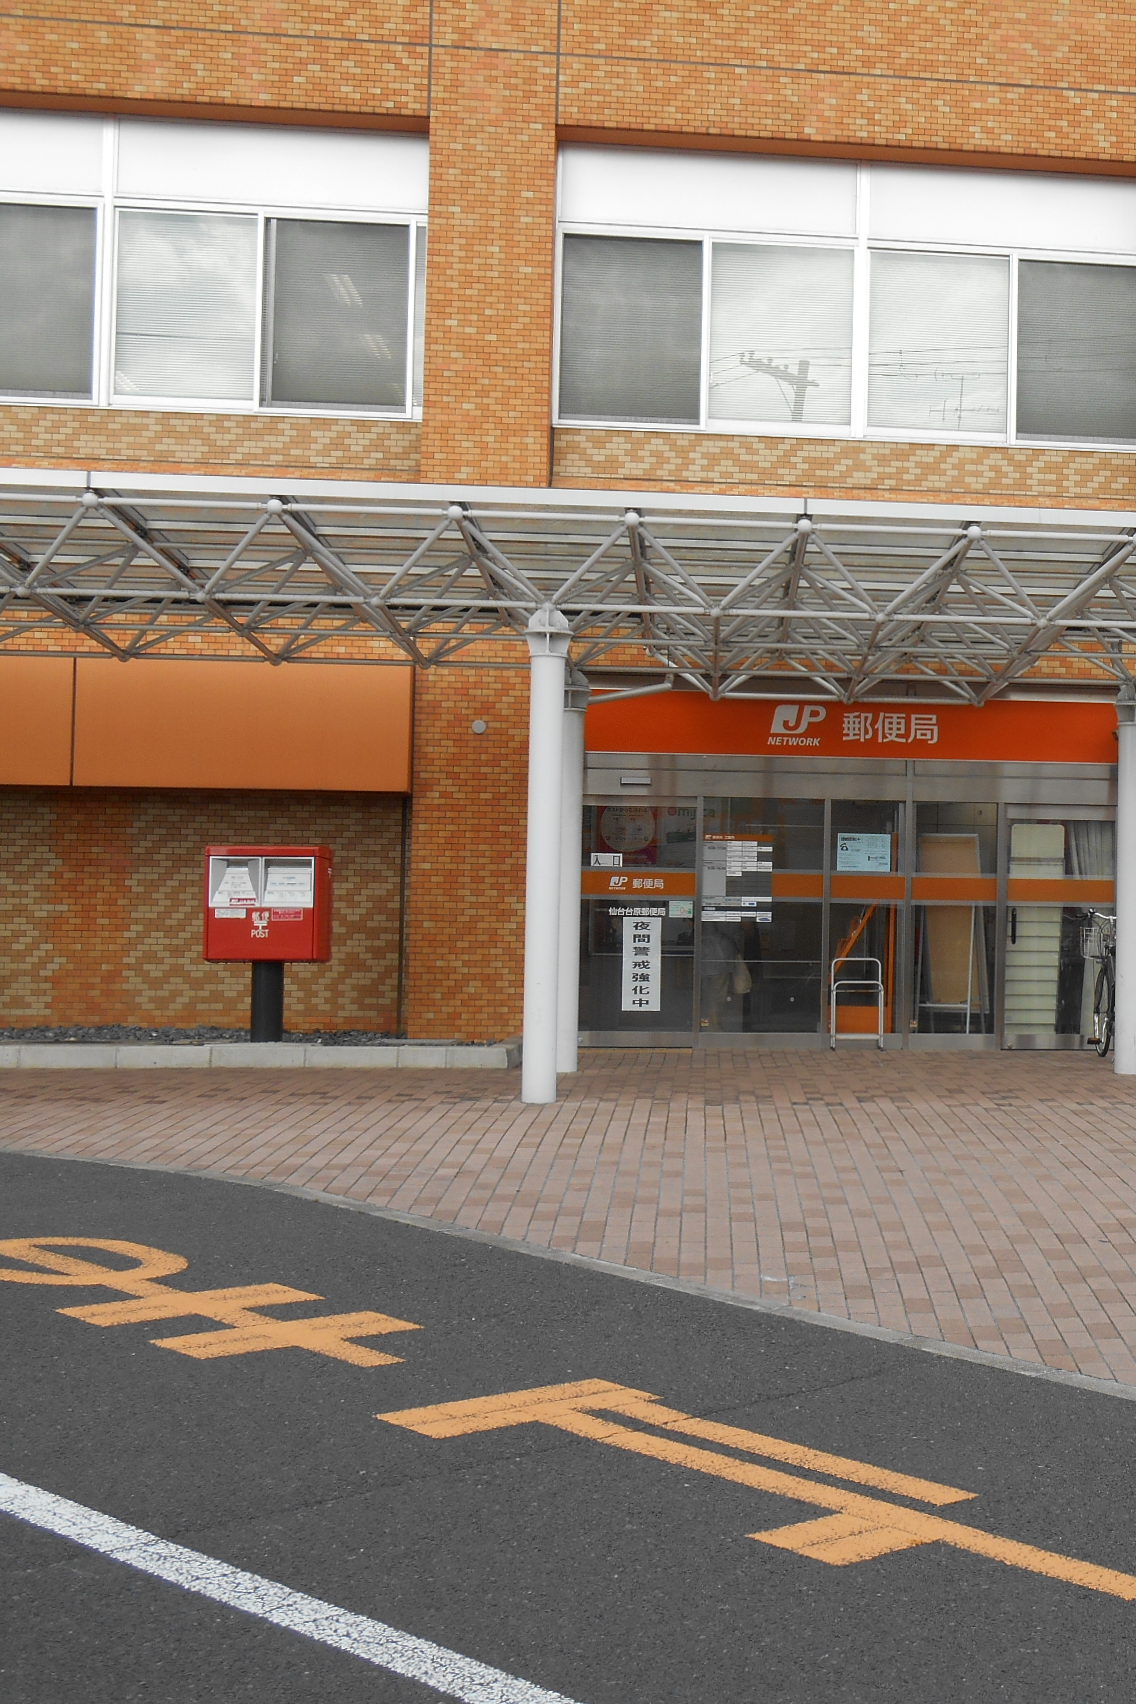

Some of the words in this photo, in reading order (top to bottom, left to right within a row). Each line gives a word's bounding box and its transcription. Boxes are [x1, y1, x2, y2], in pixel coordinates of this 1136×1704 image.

[842, 711, 940, 745] 郵便局
[767, 736, 821, 747] NETWORK
[632, 878, 664, 889] 郵便局
[608, 906, 666, 916] 仙台台原郵便局
[251, 929, 269, 938] POST
[631, 921, 651, 1007] 夜間警戒強化中
